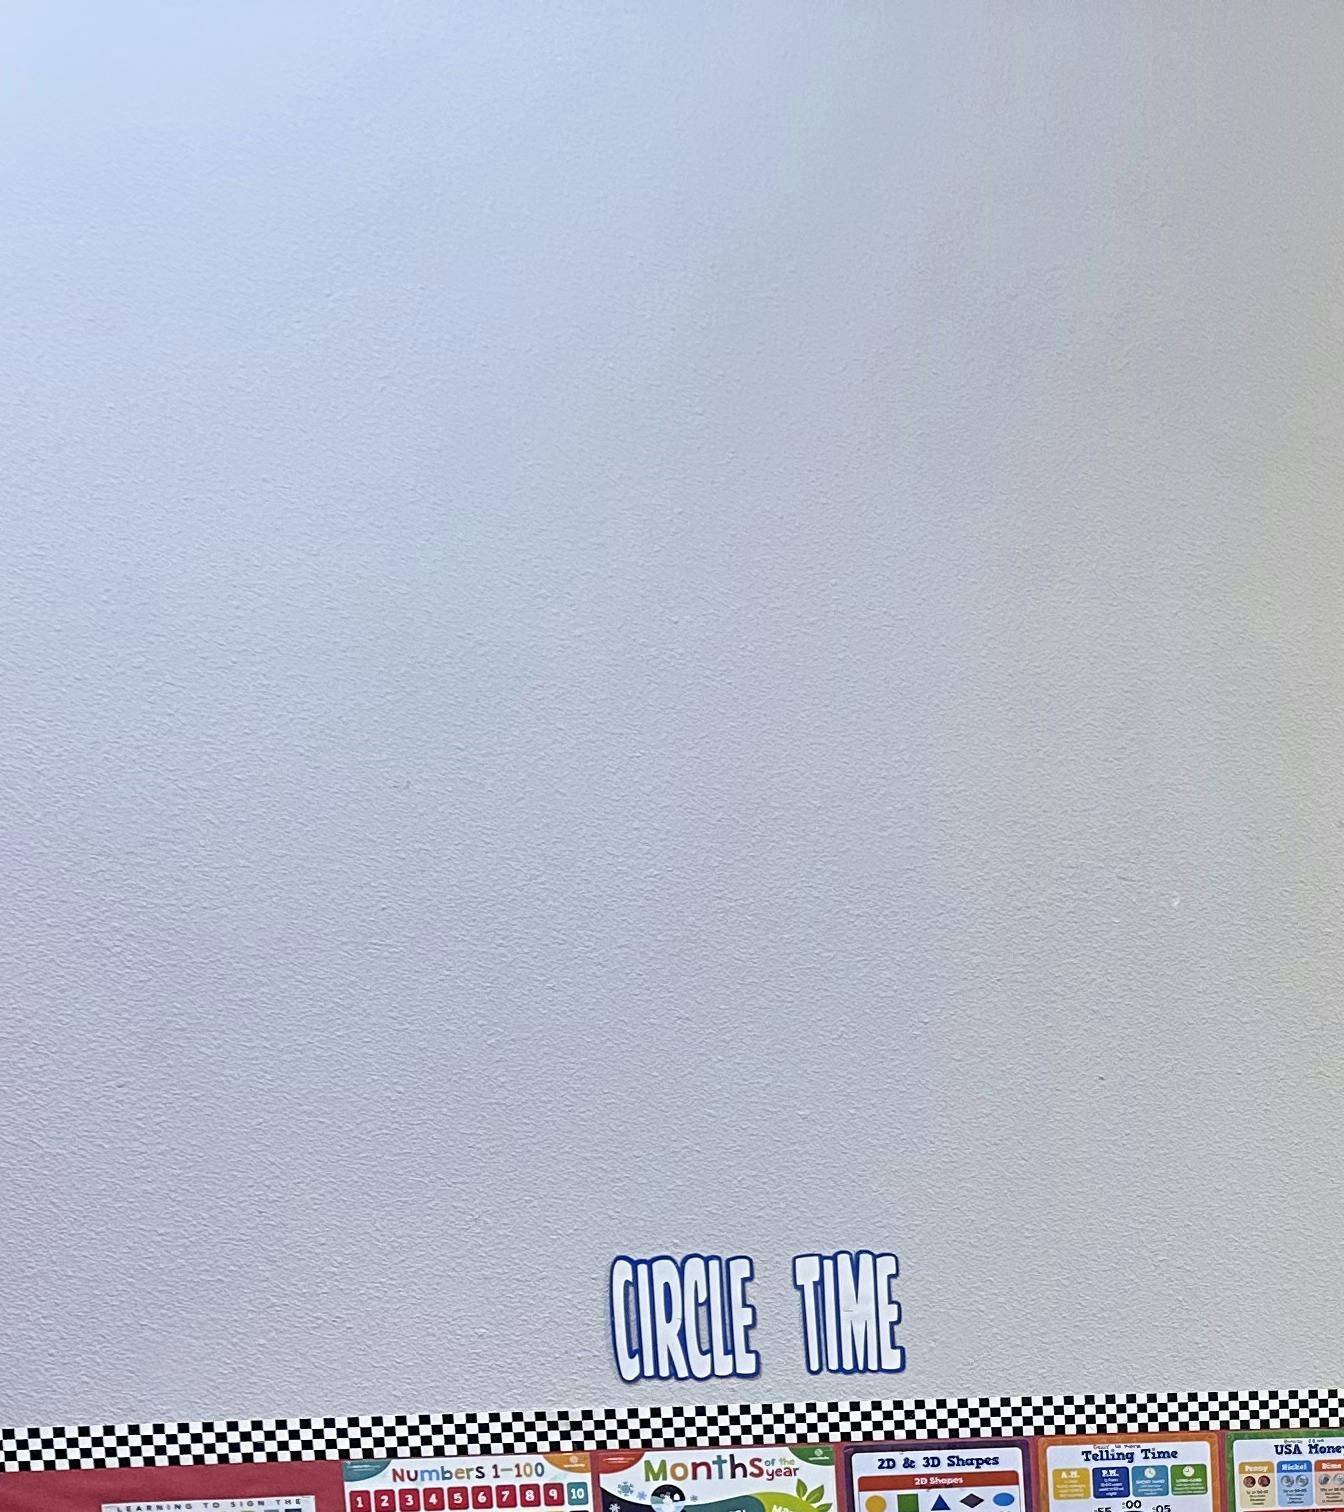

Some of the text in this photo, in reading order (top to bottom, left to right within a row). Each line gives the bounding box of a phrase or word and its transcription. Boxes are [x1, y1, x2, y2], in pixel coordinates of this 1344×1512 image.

[610, 1250, 906, 1382] CIRCLE TIME
[1082, 1448, 1178, 1463] Telling Time
[1274, 1444, 1302, 1455] USA
[643, 1454, 764, 1482] Months
[764, 1457, 795, 1467] of the
[877, 1454, 999, 1470] 2D & 3D Shapes
[391, 1464, 485, 1483] Numbers
[766, 1466, 800, 1481] year
[914, 1476, 963, 1487] 2D Shapes
[356, 1488, 584, 1508] 1 2 3 4 5 6 7 8 9 10
[117, 1504, 192, 1512] LEARNING
